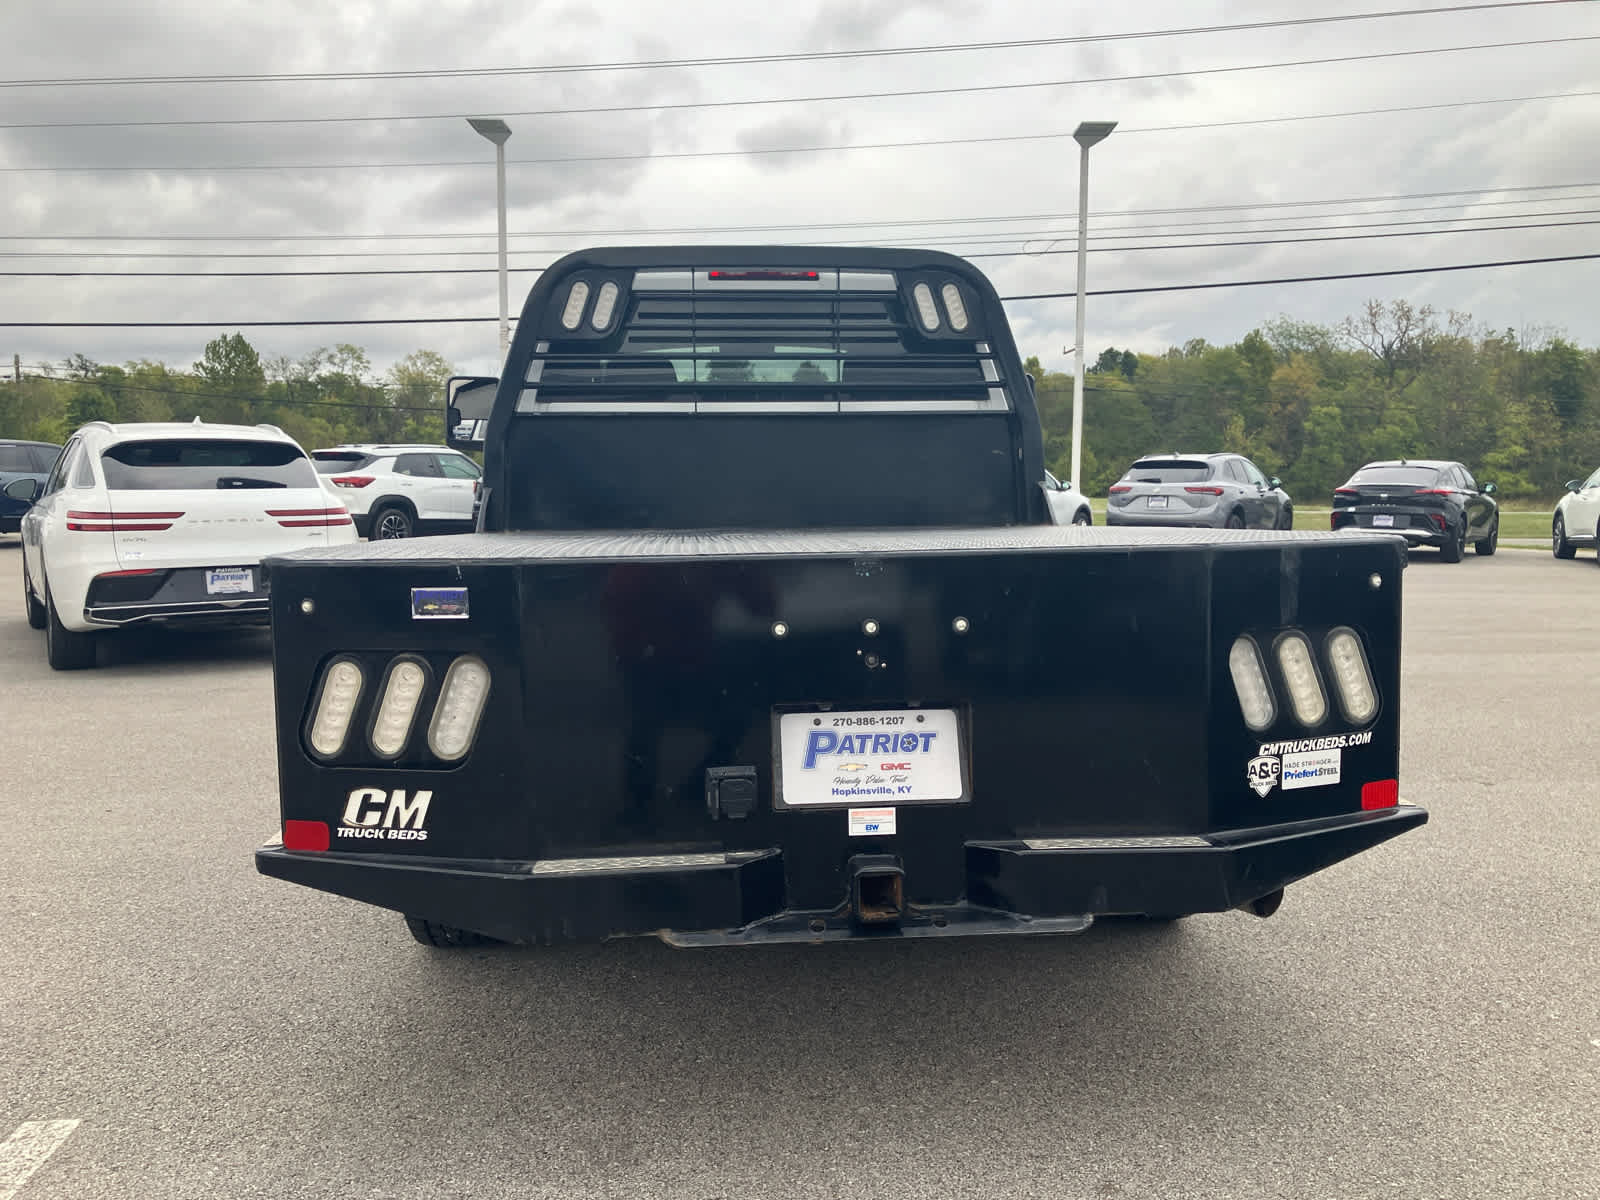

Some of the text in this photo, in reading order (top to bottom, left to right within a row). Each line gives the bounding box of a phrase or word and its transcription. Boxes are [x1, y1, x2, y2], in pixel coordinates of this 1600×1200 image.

[832, 716, 905, 727] 270-886-1207
[803, 729, 937, 769] PATRIOT
[1259, 731, 1373, 756] CMTRUCKBEDS.COM
[880, 762, 912, 771] GMC
[832, 785, 913, 798] Hopkinsville, KY
[343, 788, 433, 829] CM
[337, 828, 428, 841] TRUCK BEDS
